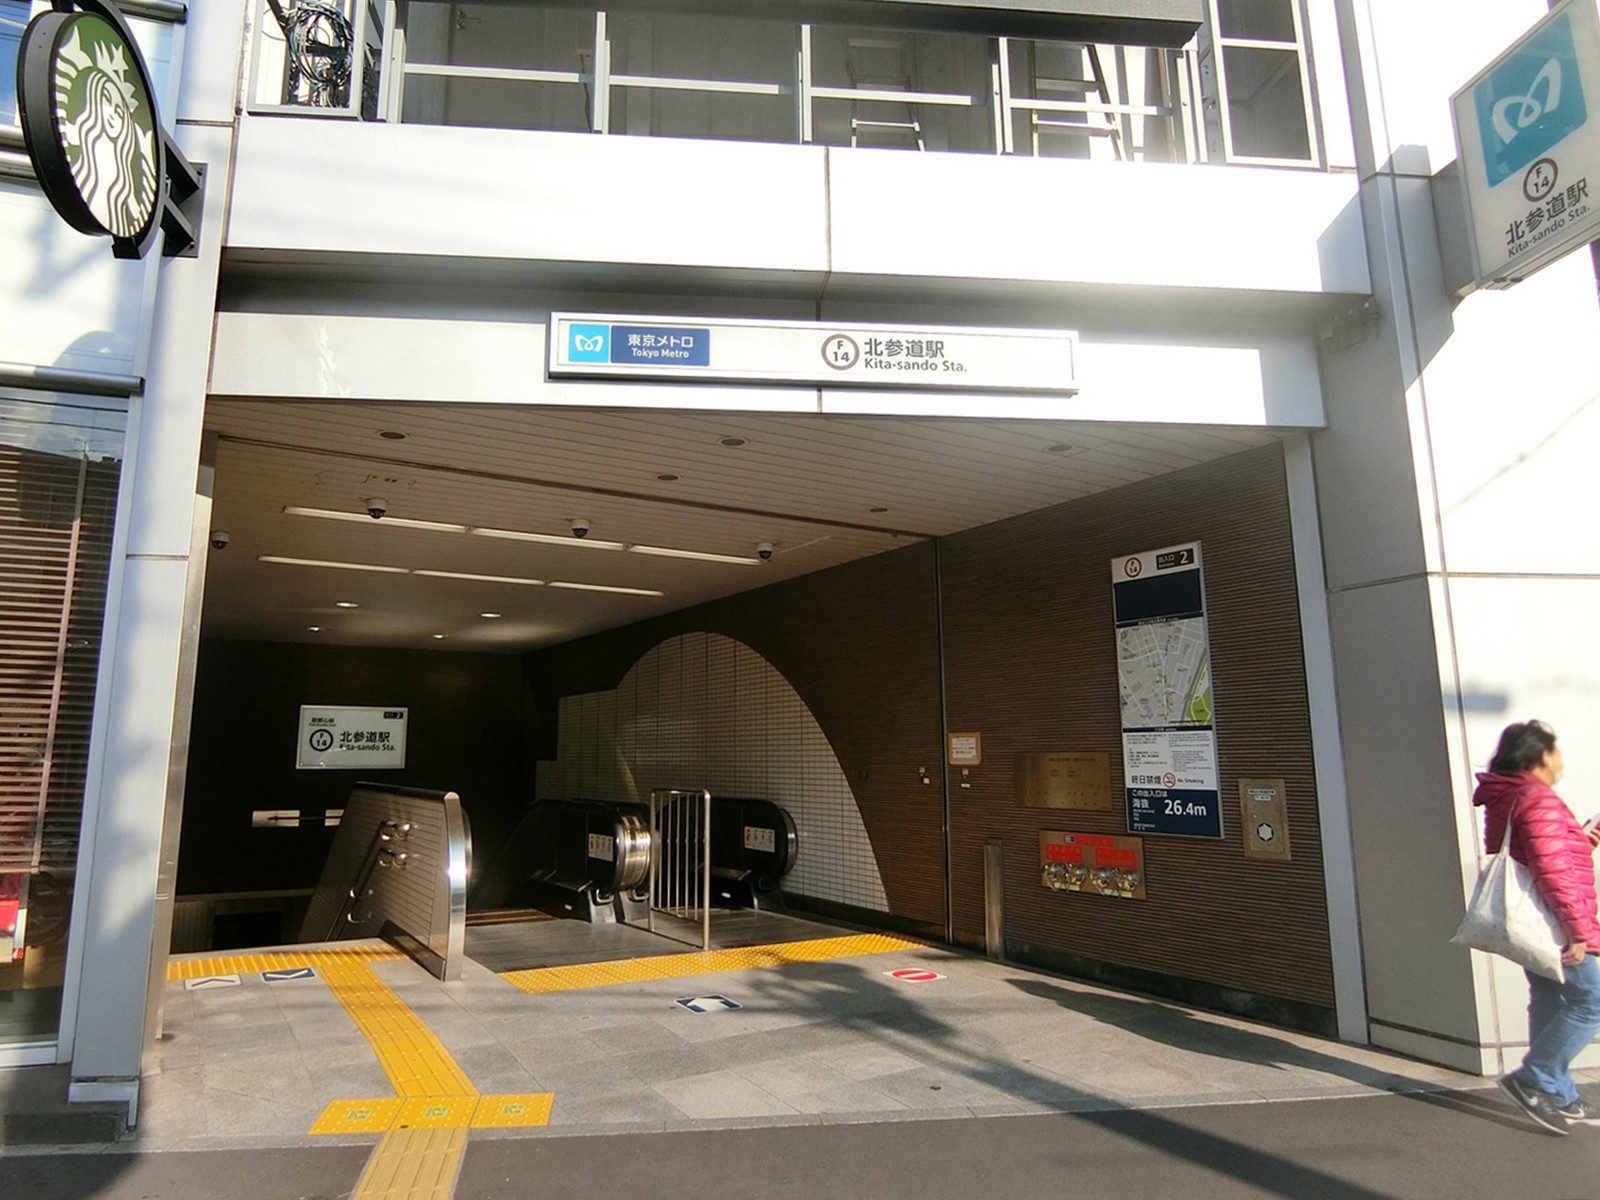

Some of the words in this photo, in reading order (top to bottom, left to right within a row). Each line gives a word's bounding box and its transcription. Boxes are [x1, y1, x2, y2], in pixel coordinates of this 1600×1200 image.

[1535, 166, 1542, 179] F
[1533, 175, 1550, 193] 14
[1504, 177, 1589, 246] 北参道駅
[1507, 218, 1565, 258] Kita-sando
[1567, 204, 1591, 222] Sta.
[627, 333, 694, 348] 東京メトロ
[836, 340, 844, 350] F
[632, 347, 654, 359] Tokyo
[661, 348, 690, 359] Metro
[863, 337, 945, 359] 北参道駅
[832, 351, 850, 363] 14
[864, 357, 938, 372] Kita-sando
[942, 359, 968, 373] Sta.
[1180, 551, 1189, 564] 2
[316, 739, 327, 747] 14
[340, 731, 390, 743] 北参道駅
[1164, 799, 1207, 816] 26.4m
